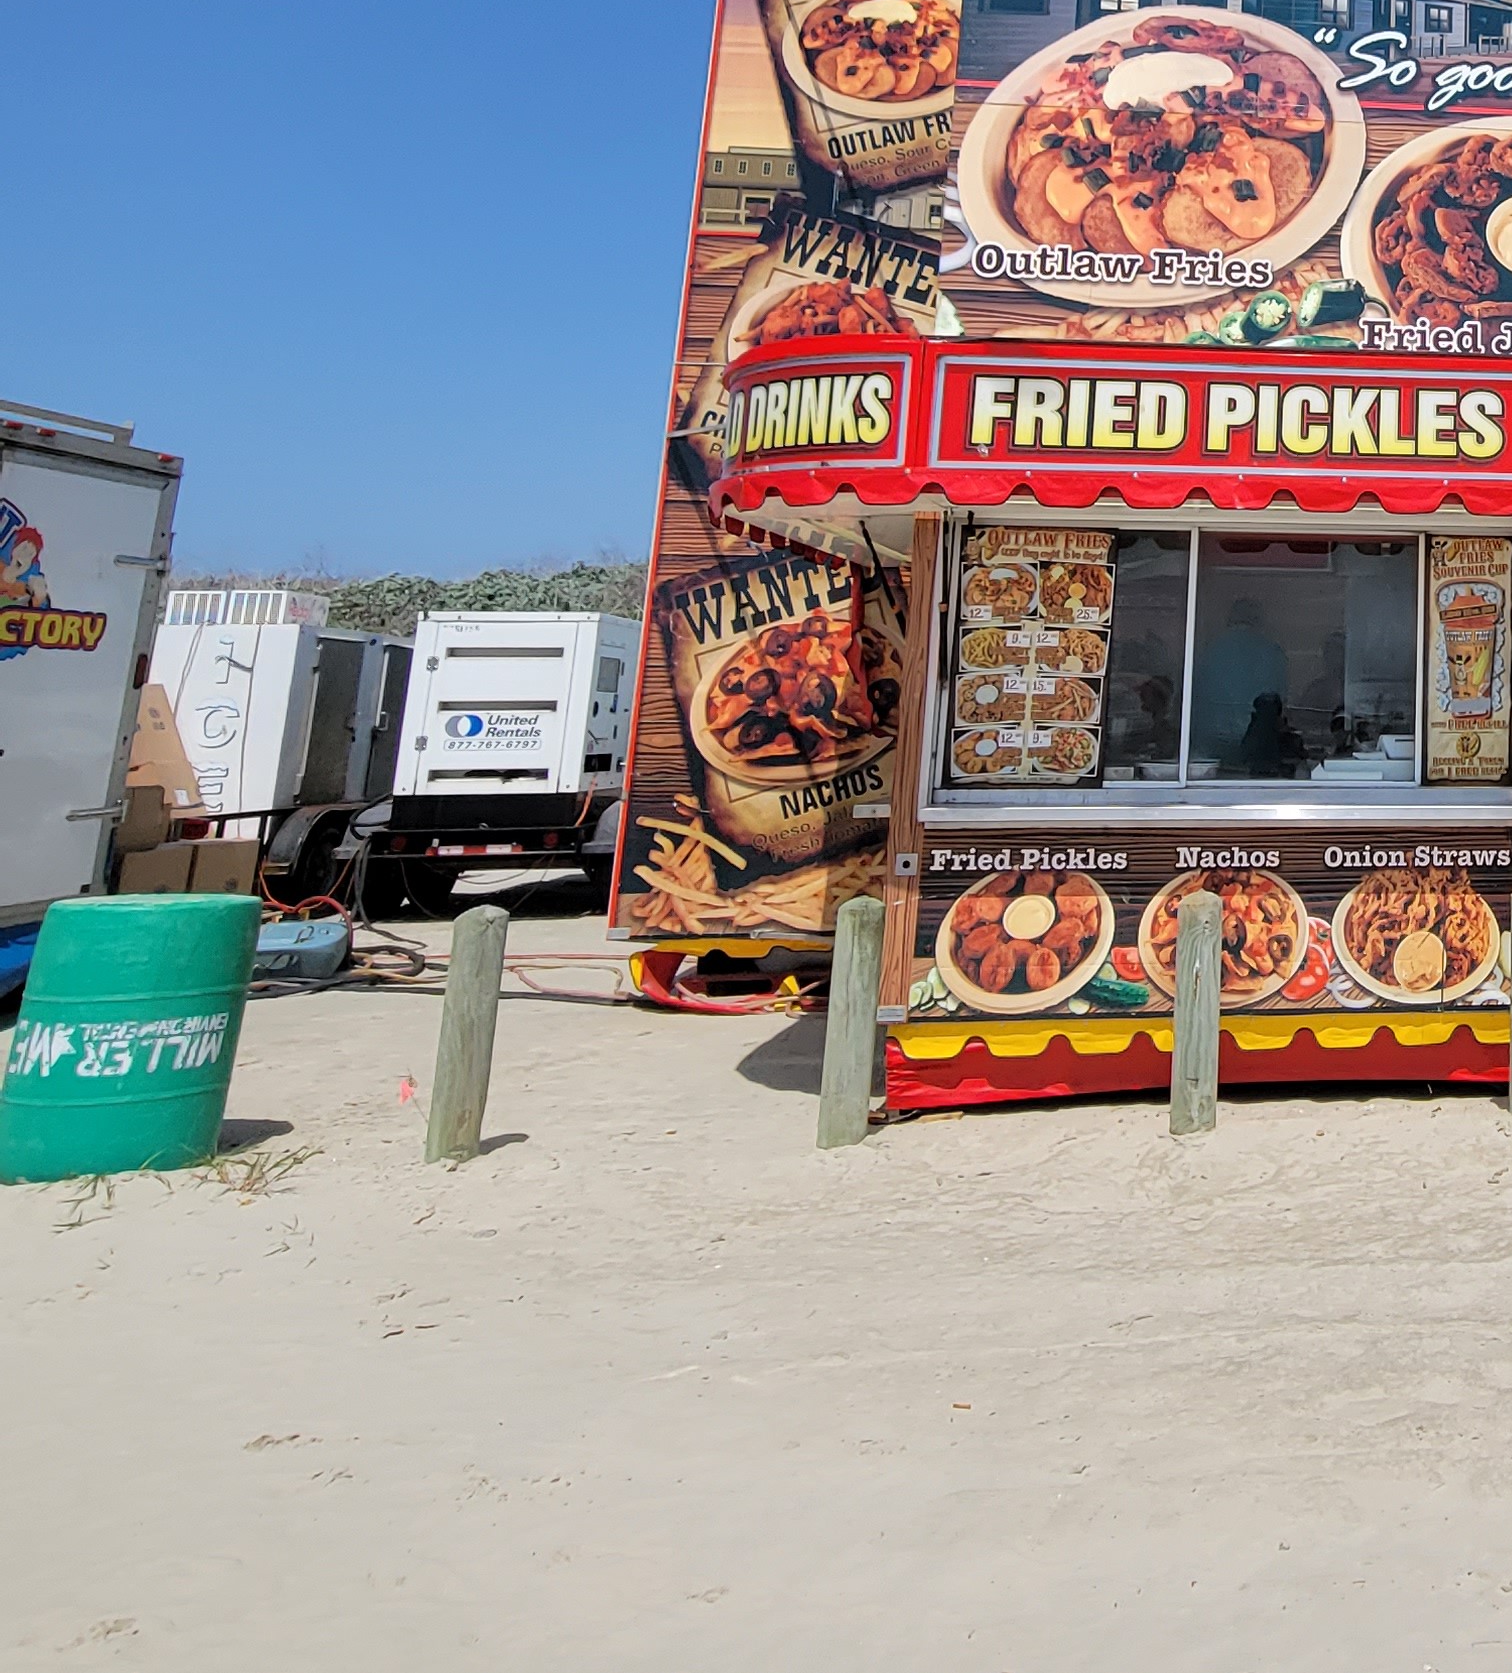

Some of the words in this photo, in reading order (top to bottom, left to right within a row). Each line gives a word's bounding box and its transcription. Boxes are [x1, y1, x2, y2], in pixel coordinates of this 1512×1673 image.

[827, 119, 916, 160] OUTLAW
[783, 210, 941, 307] WANTE
[974, 243, 1140, 285] Outlaw
[1151, 249, 1273, 288] Fries
[1359, 317, 1485, 353] Fried
[745, 372, 893, 454] DRINKS
[968, 375, 1187, 449] FRIED
[1204, 382, 1506, 458] PICKLES
[988, 529, 1059, 547] OUTLAW
[1064, 531, 1111, 550] FRIES
[1453, 539, 1504, 552] OUTLAW
[1460, 551, 1495, 564] FRIES
[1433, 565, 1486, 581] SOUVENIR
[1488, 563, 1509, 577] CUP
[674, 559, 864, 644] WANTE
[485, 727, 541, 738] Rentals
[487, 715, 539, 727] United
[447, 740, 538, 750] 877-767-6797
[779, 764, 884, 819] NACHOS
[930, 848, 1012, 871] Fried
[1019, 847, 1129, 871] Pickles
[1175, 846, 1281, 869] Nachos
[1323, 845, 1407, 868] Onion
[1414, 845, 1512, 868] Straws
